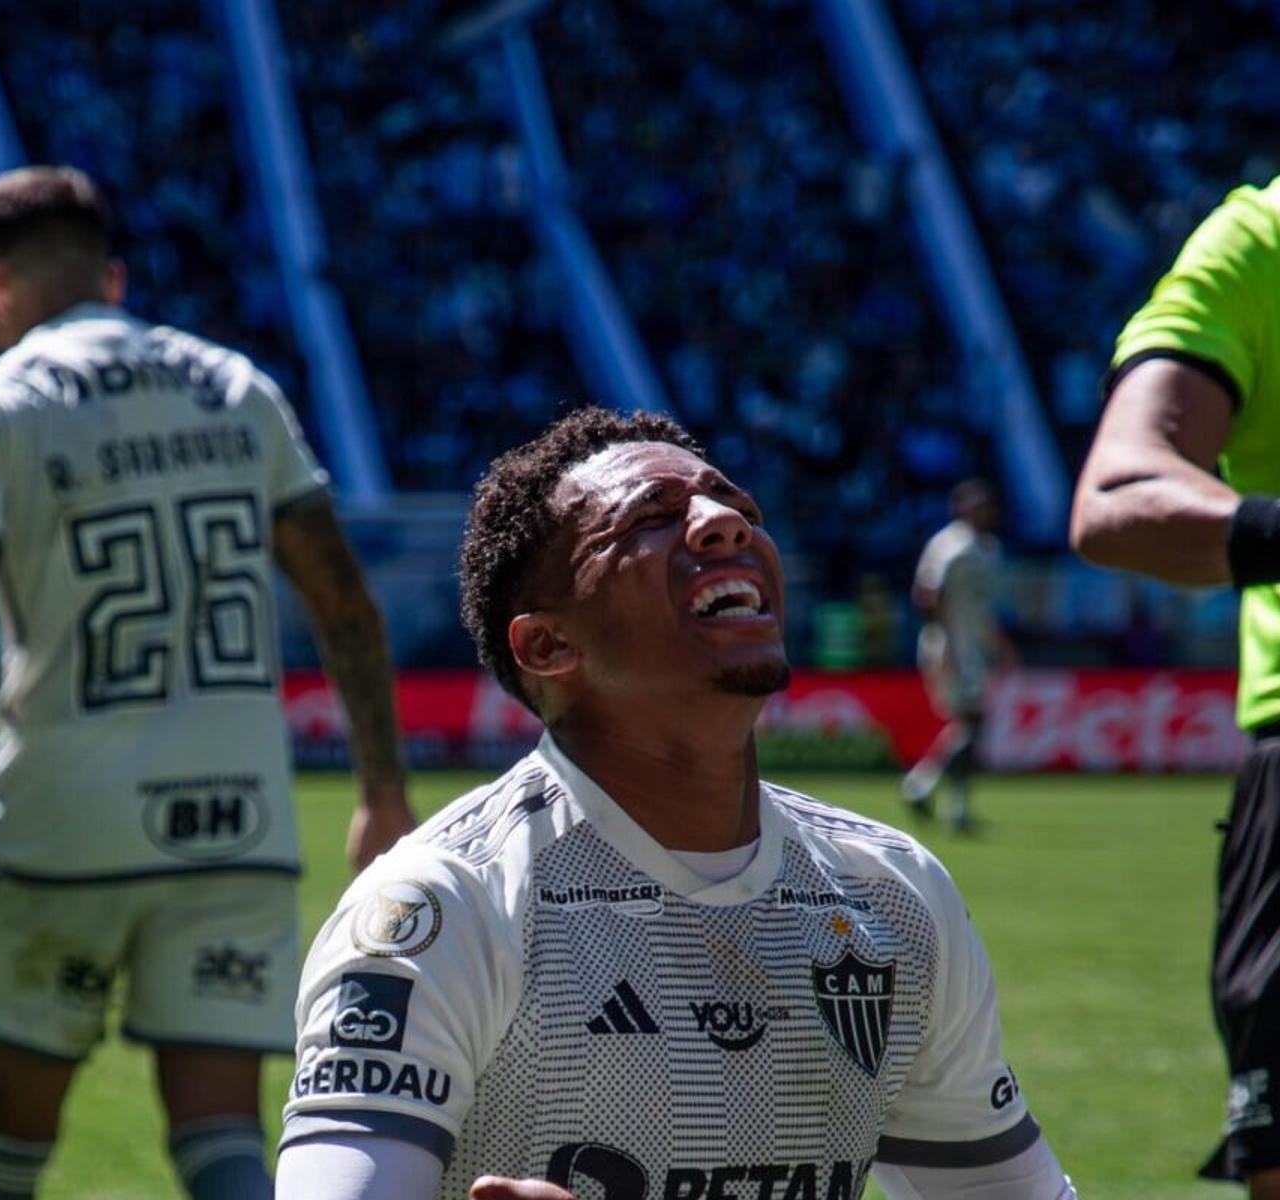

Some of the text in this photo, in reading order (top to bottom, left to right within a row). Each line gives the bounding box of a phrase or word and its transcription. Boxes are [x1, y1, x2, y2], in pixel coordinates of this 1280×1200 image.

[69, 492, 273, 711] 26
[167, 796, 243, 841] BH
[540, 885, 662, 905] Multimarcas
[824, 972, 885, 994] CAM
[689, 1001, 754, 1032] YOU
[295, 1058, 452, 1105] GERDAU
